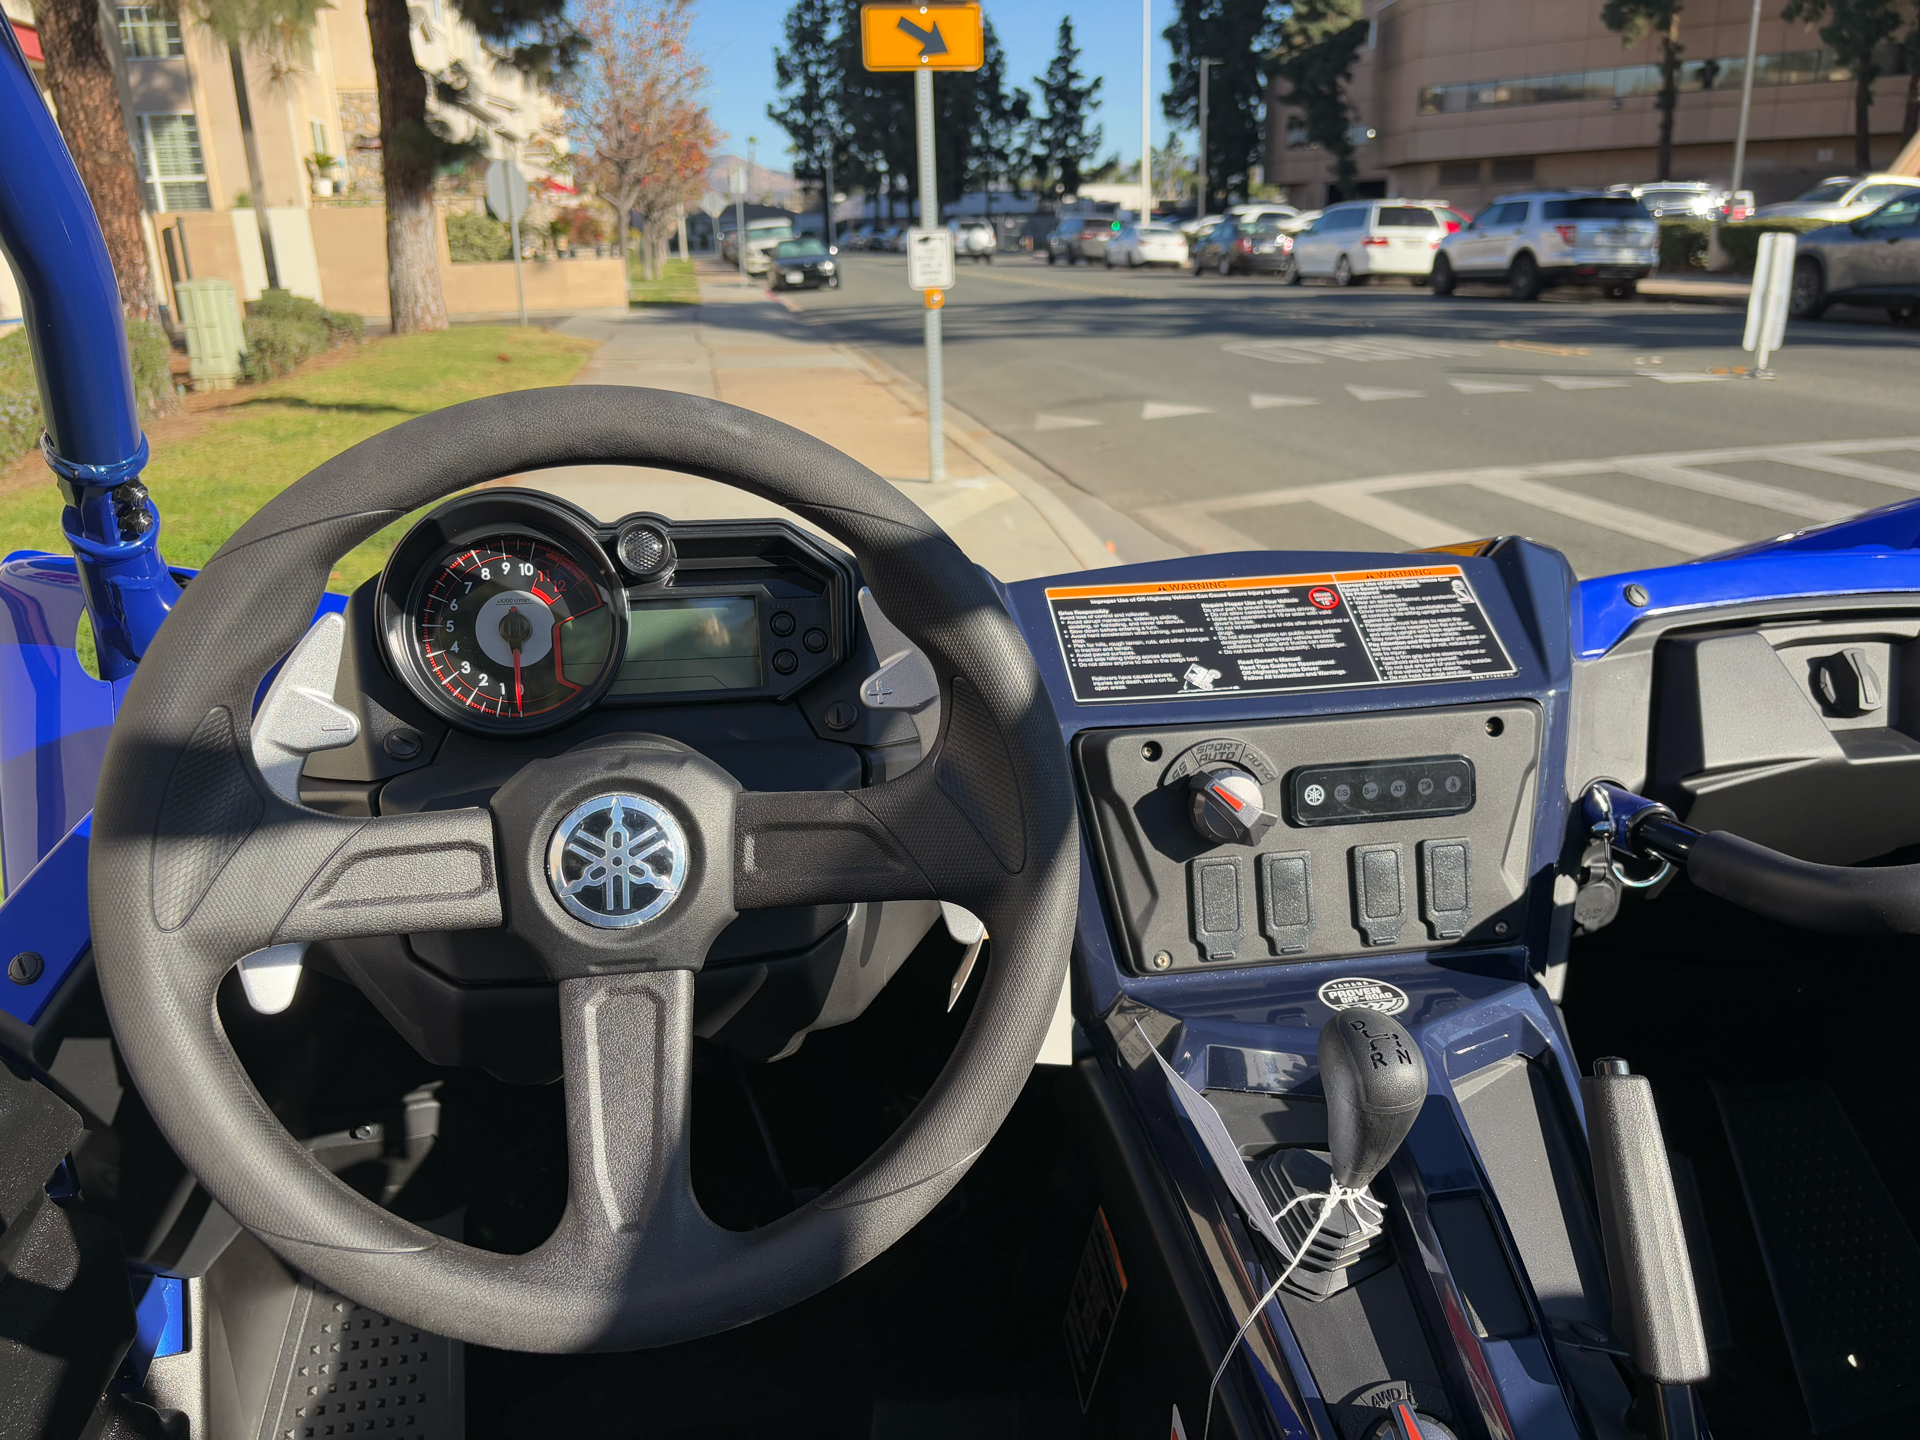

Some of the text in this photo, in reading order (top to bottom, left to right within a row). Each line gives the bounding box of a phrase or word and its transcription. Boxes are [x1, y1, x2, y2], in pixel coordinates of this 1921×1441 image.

[502, 562, 510, 574] 9
[519, 563, 534, 576] 10
[1377, 568, 1432, 578] WARNING
[481, 569, 490, 580] 8
[538, 570, 550, 582] 11
[464, 582, 473, 594] 7
[553, 580, 566, 593] 12
[1168, 581, 1227, 591] WARNING
[450, 600, 458, 610] 6
[446, 621, 454, 632] 5
[450, 640, 459, 652] 4
[461, 661, 471, 674] 3
[479, 674, 488, 686] 2
[499, 683, 505, 695] 1
[1197, 742, 1243, 754] SPORT
[1200, 752, 1236, 761] AUTO
[1244, 753, 1273, 780] AUTO
[1328, 986, 1382, 999] PROVEN
[1340, 992, 1393, 1004] OFF-ROAD
[1350, 1020, 1365, 1030] D
[1370, 1052, 1387, 1069] R
[1396, 1049, 1412, 1064] N
